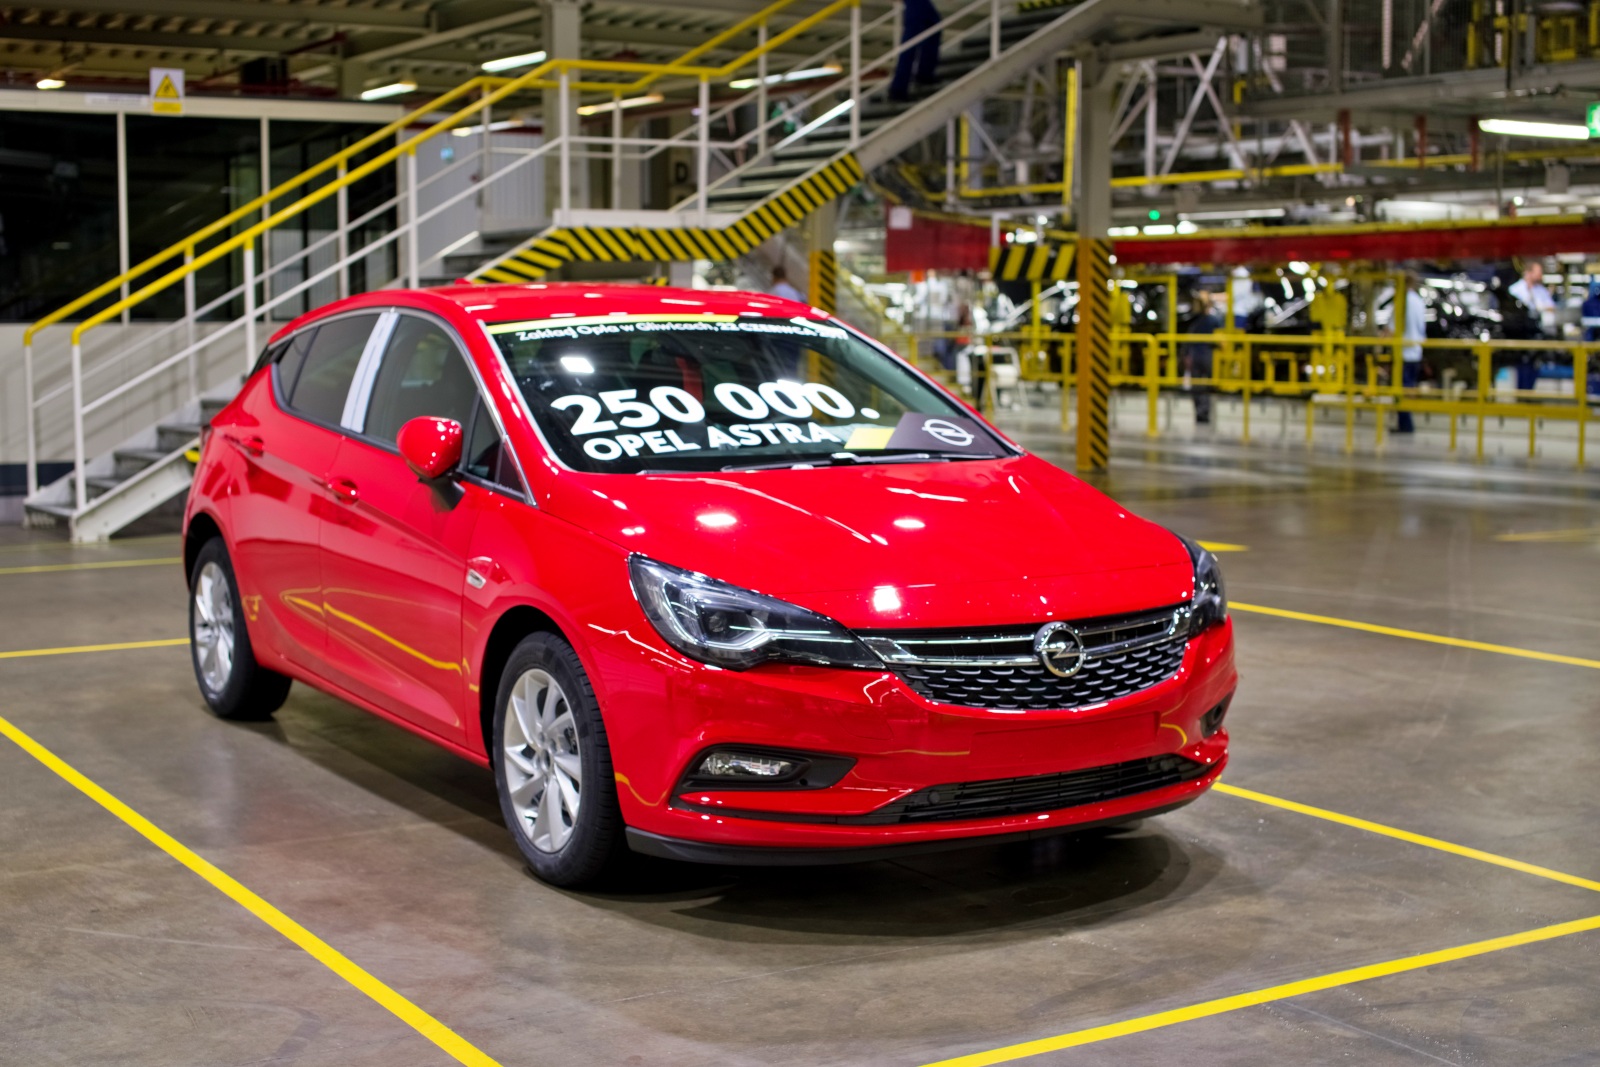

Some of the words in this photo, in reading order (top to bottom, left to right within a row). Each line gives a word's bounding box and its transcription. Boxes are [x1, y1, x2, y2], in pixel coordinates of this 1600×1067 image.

[550, 385, 706, 436] 250
[583, 429, 702, 461] OPEL
[706, 421, 842, 449] ASTRA
